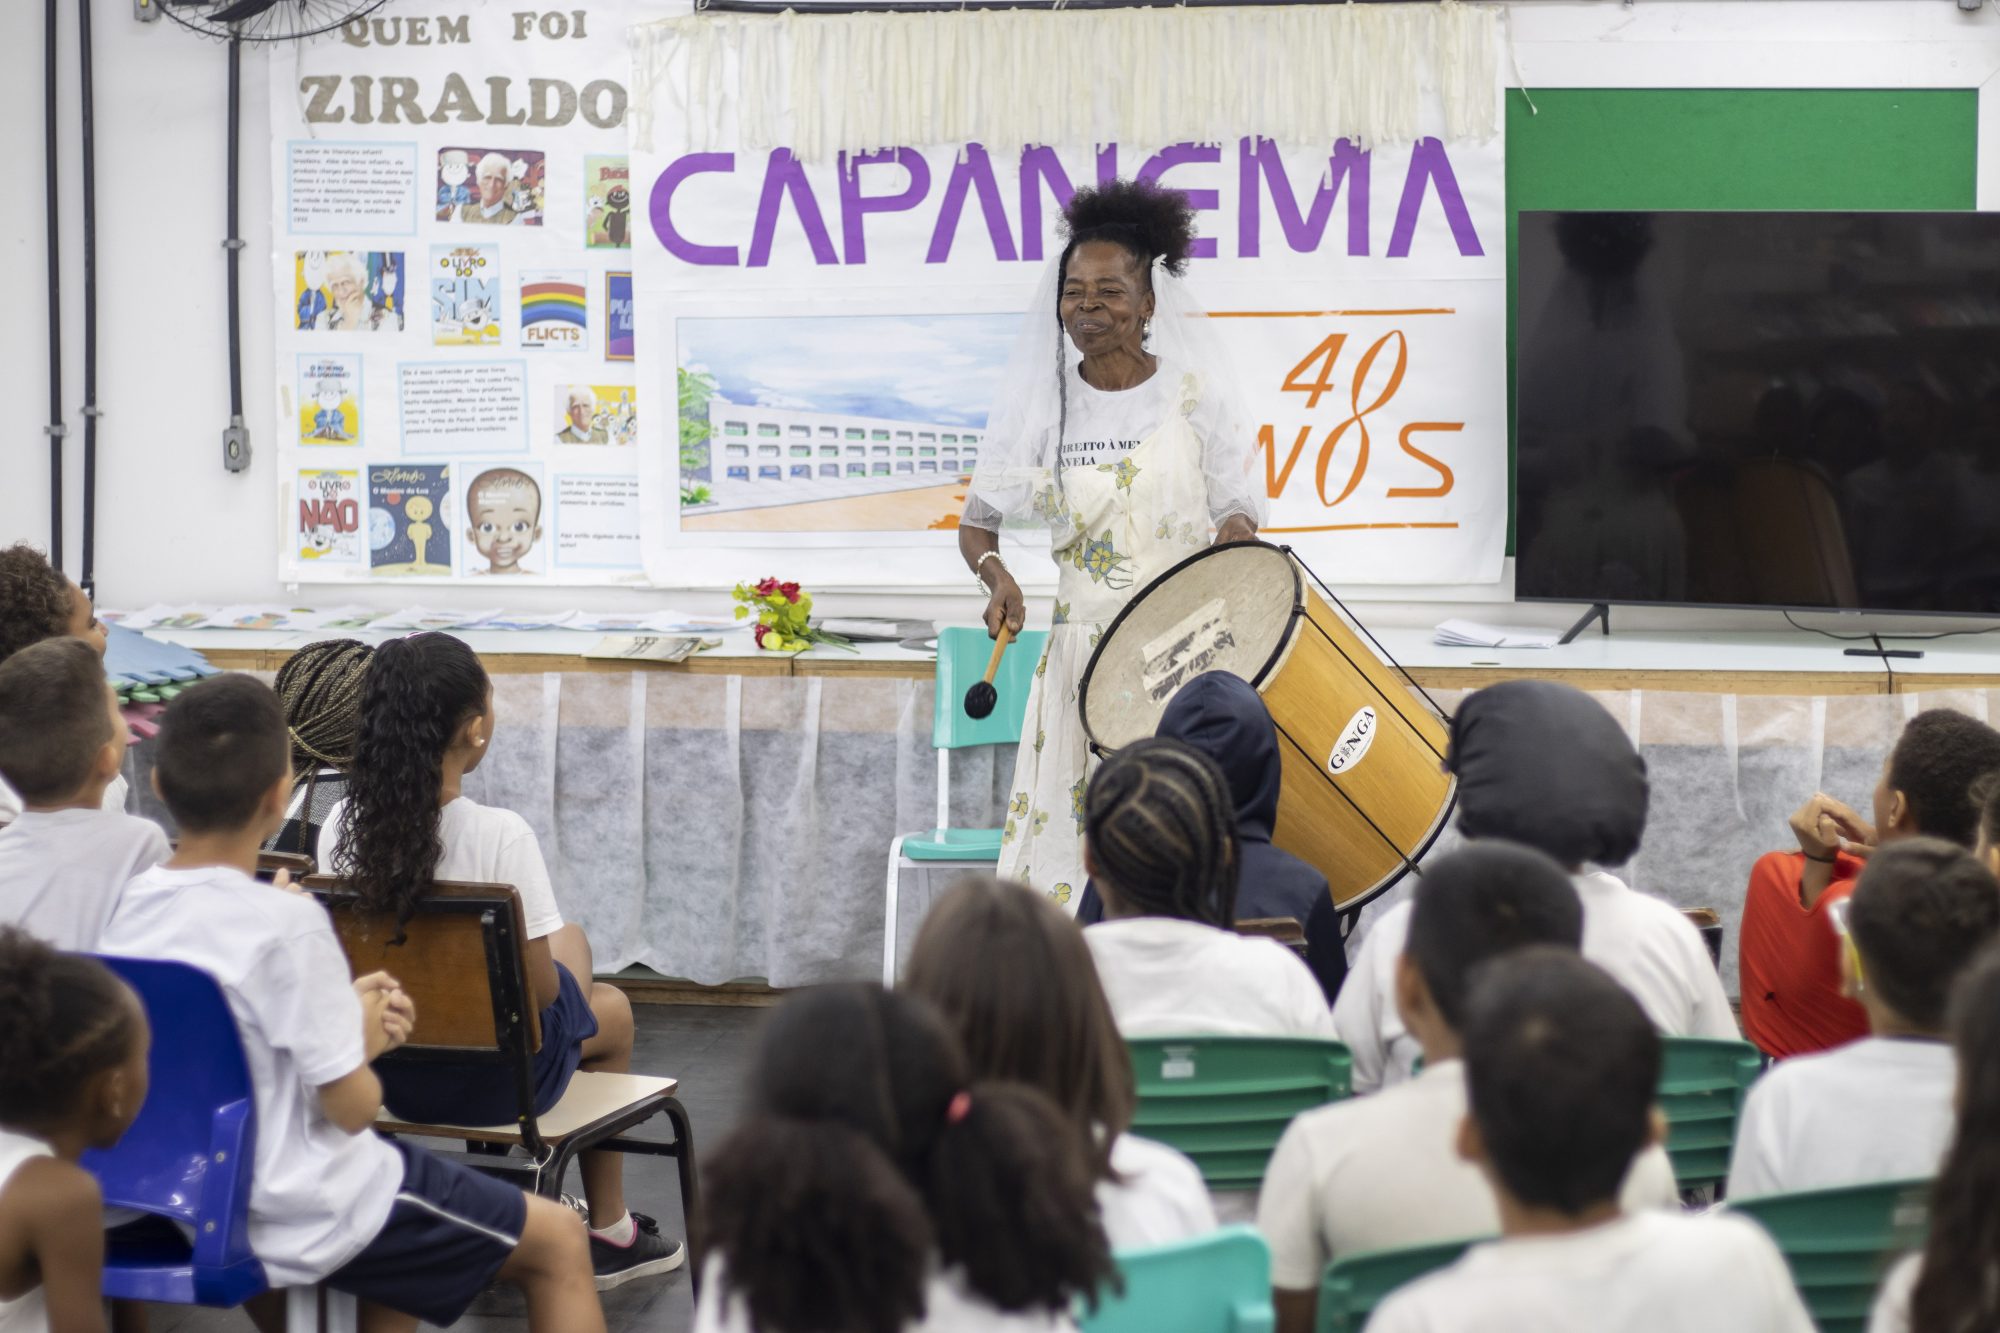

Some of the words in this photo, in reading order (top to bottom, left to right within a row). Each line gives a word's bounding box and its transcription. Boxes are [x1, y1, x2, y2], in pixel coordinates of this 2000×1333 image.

[342, 14, 471, 47] QUEM
[512, 10, 588, 41] FOI
[300, 72, 628, 129] ZIRALDO
[648, 134, 1485, 268] CAPANEMA
[527, 326, 581, 342] FLICTS
[1280, 329, 1408, 418] 40
[1059, 456, 1096, 468] AVELA
[1109, 438, 1116, 450] À
[1244, 415, 1465, 508] NOS
[319, 480, 351, 491] LIVRO
